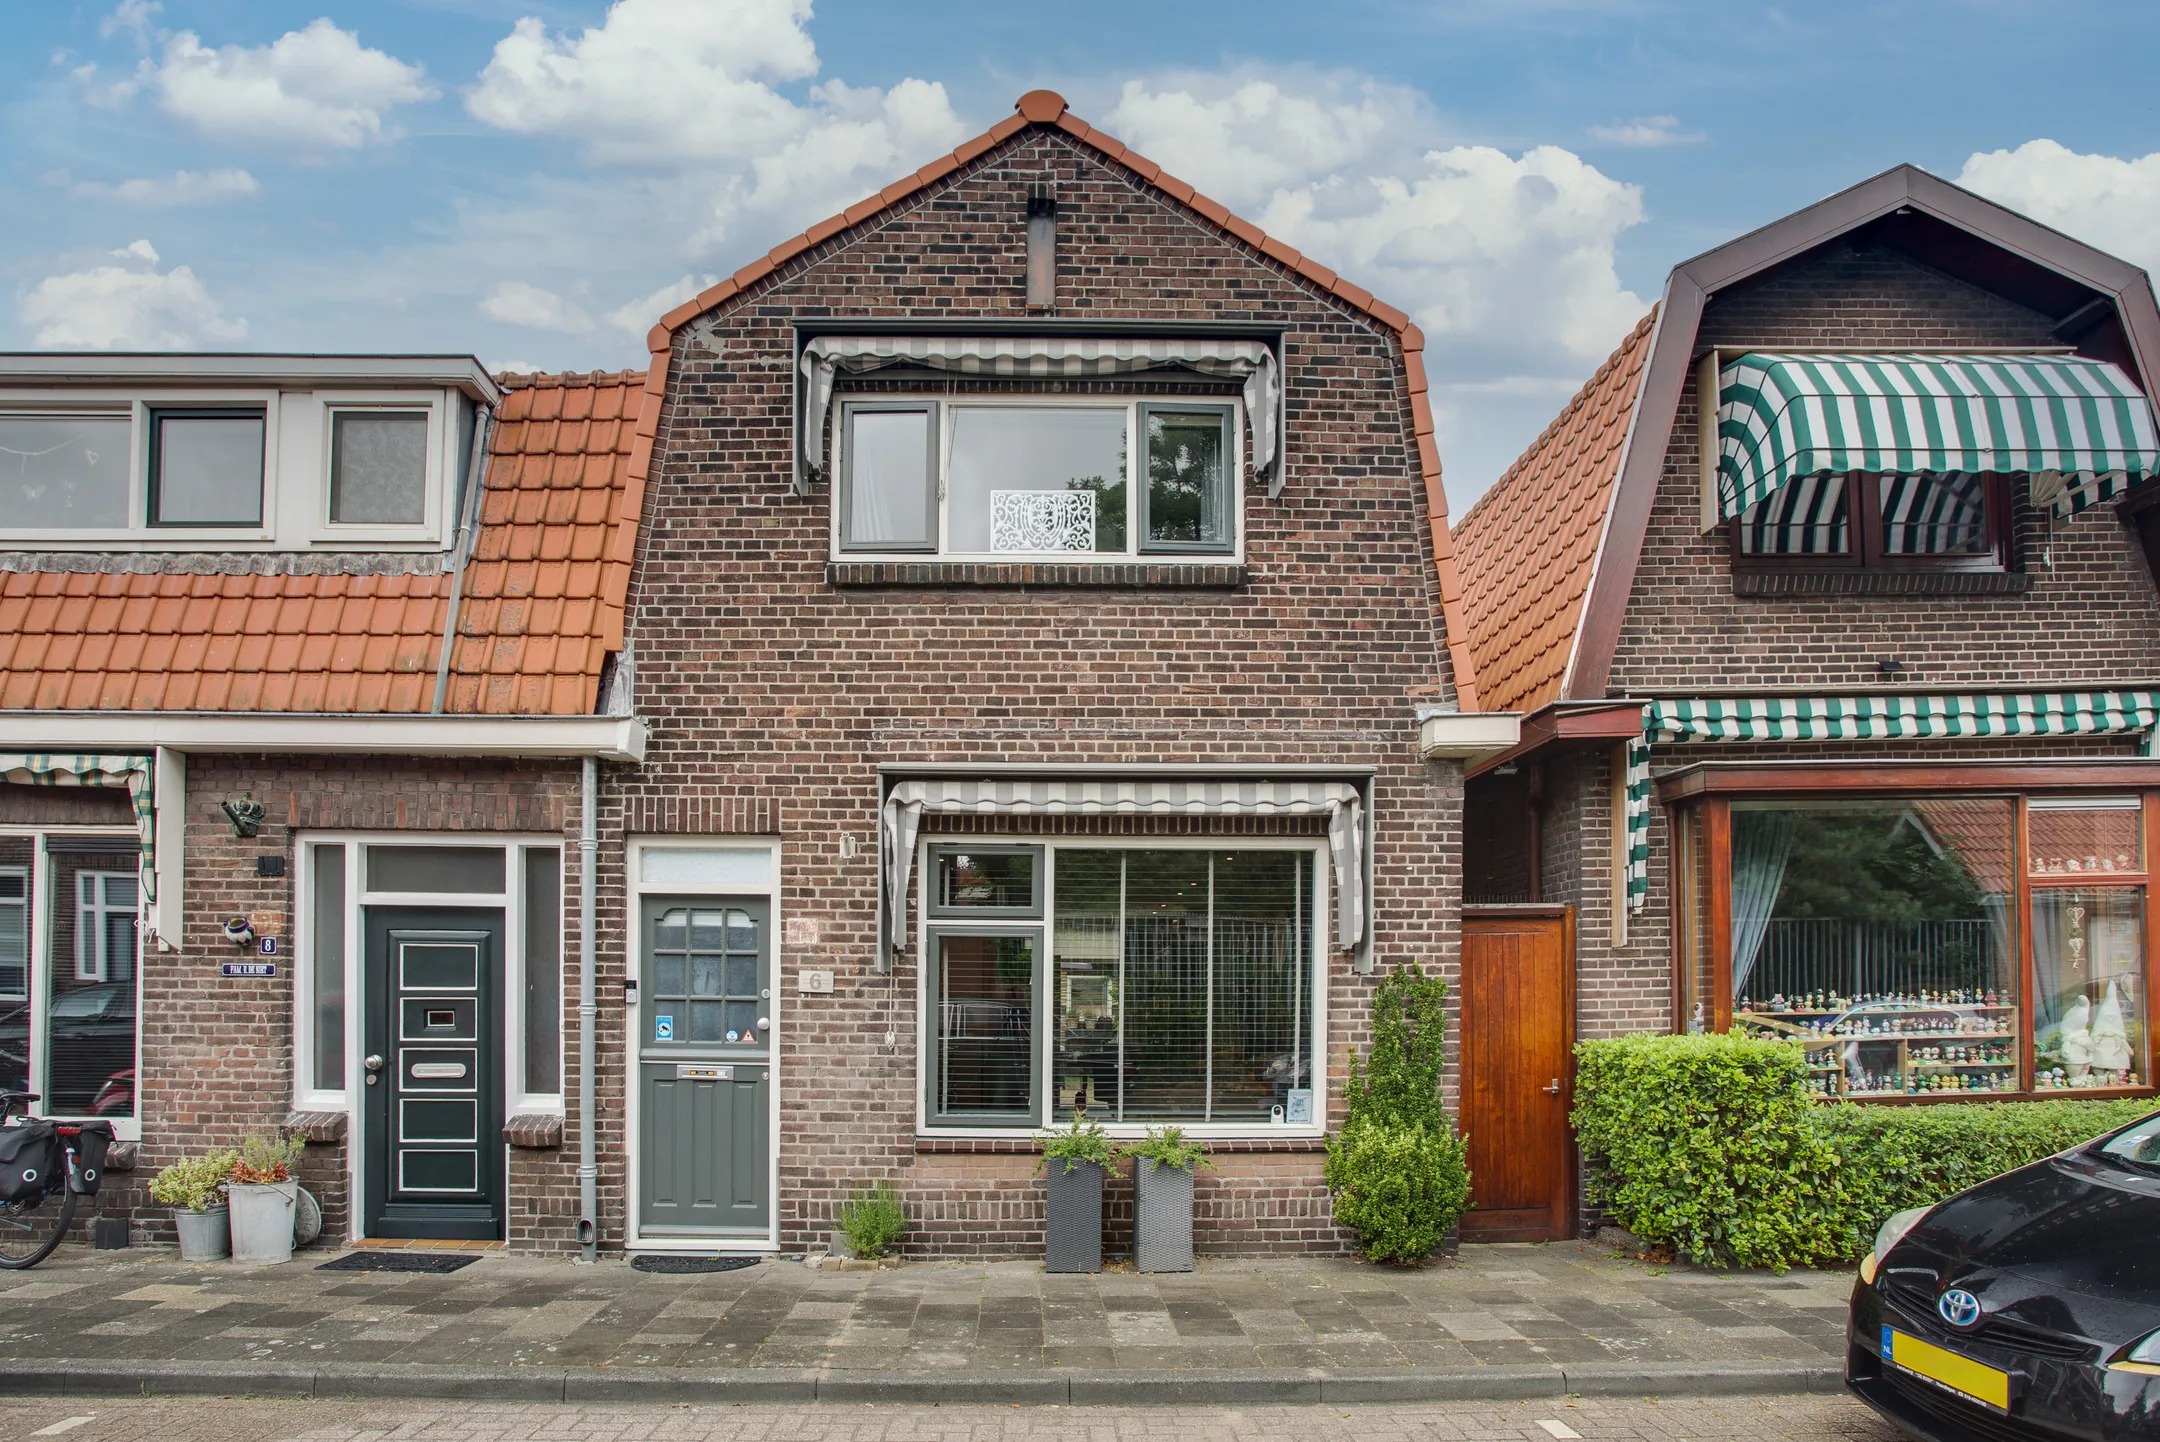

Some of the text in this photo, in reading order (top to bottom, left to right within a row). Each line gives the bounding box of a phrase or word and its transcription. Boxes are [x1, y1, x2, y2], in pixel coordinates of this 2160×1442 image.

[265, 939, 271, 951] 8
[810, 973, 821, 990] 6
[1883, 1345, 1892, 1355] NL
